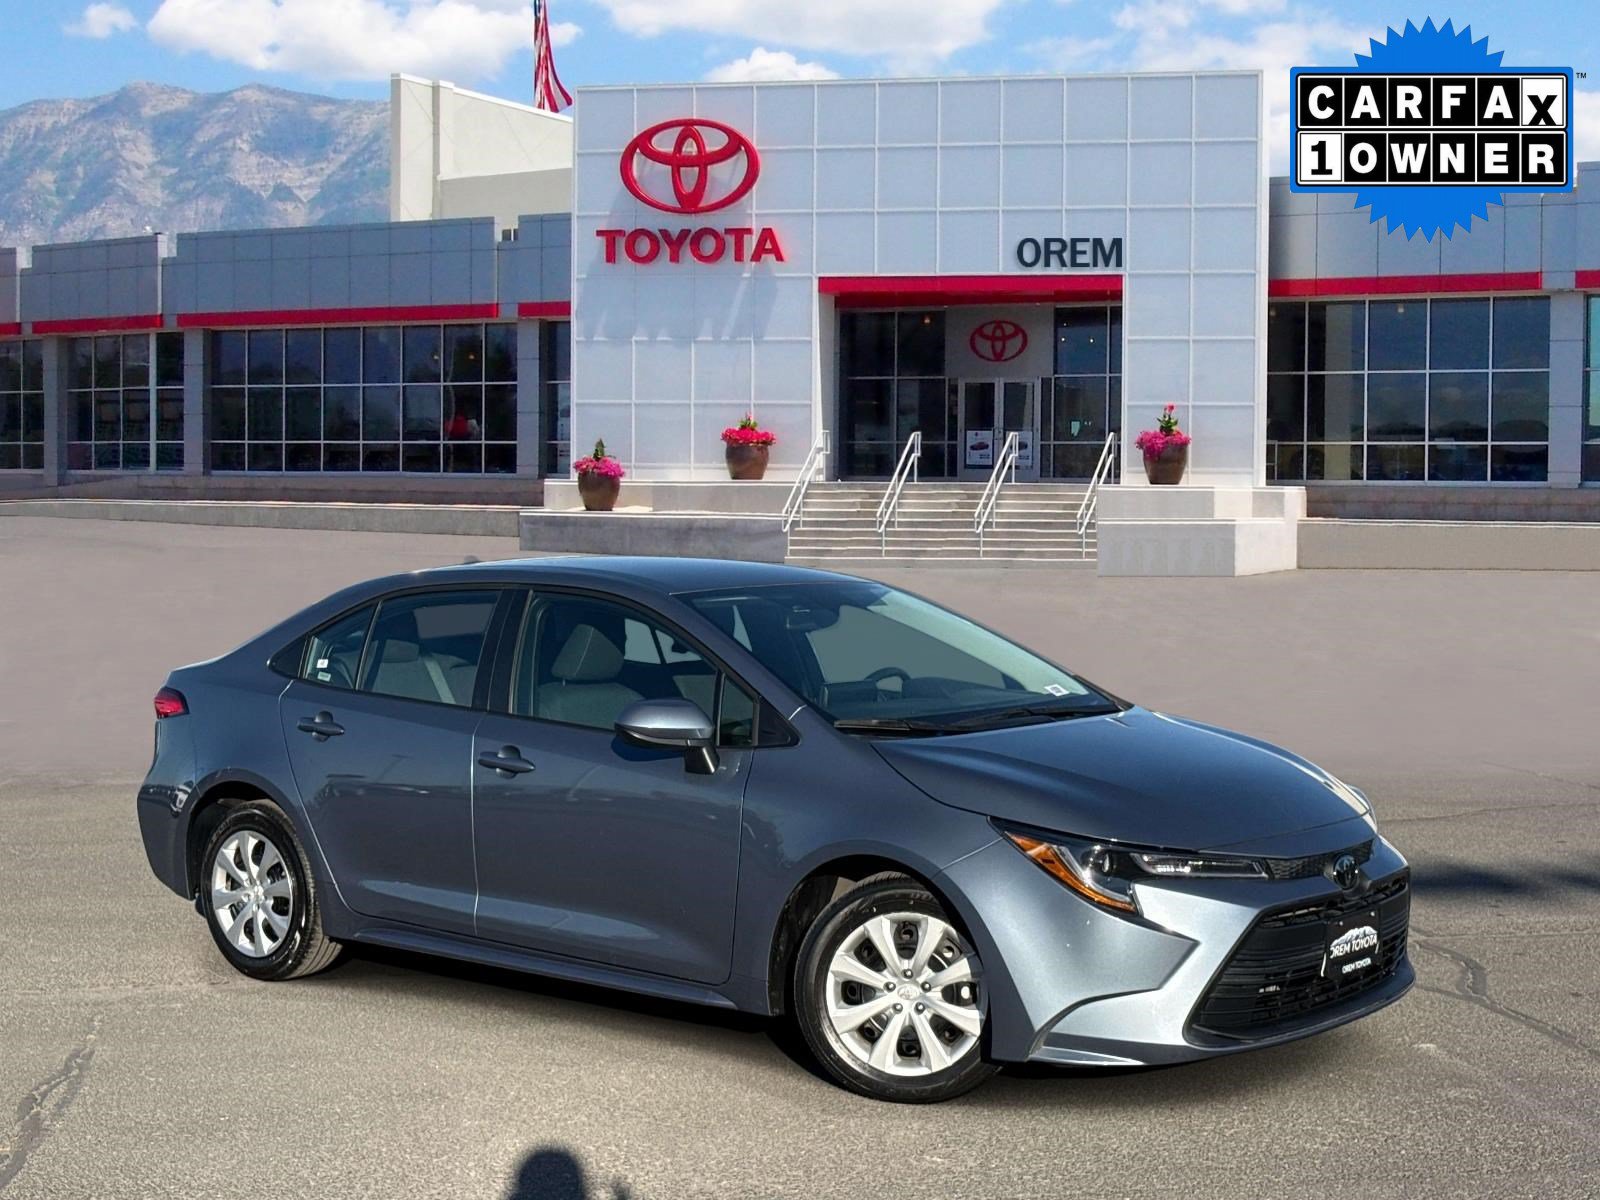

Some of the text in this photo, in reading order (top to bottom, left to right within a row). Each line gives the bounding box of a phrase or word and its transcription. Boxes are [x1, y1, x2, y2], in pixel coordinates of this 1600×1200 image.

[596, 227, 784, 264] TOYOTA
[1017, 237, 1122, 268] OREM
[1351, 934, 1378, 952] TOYOTA
